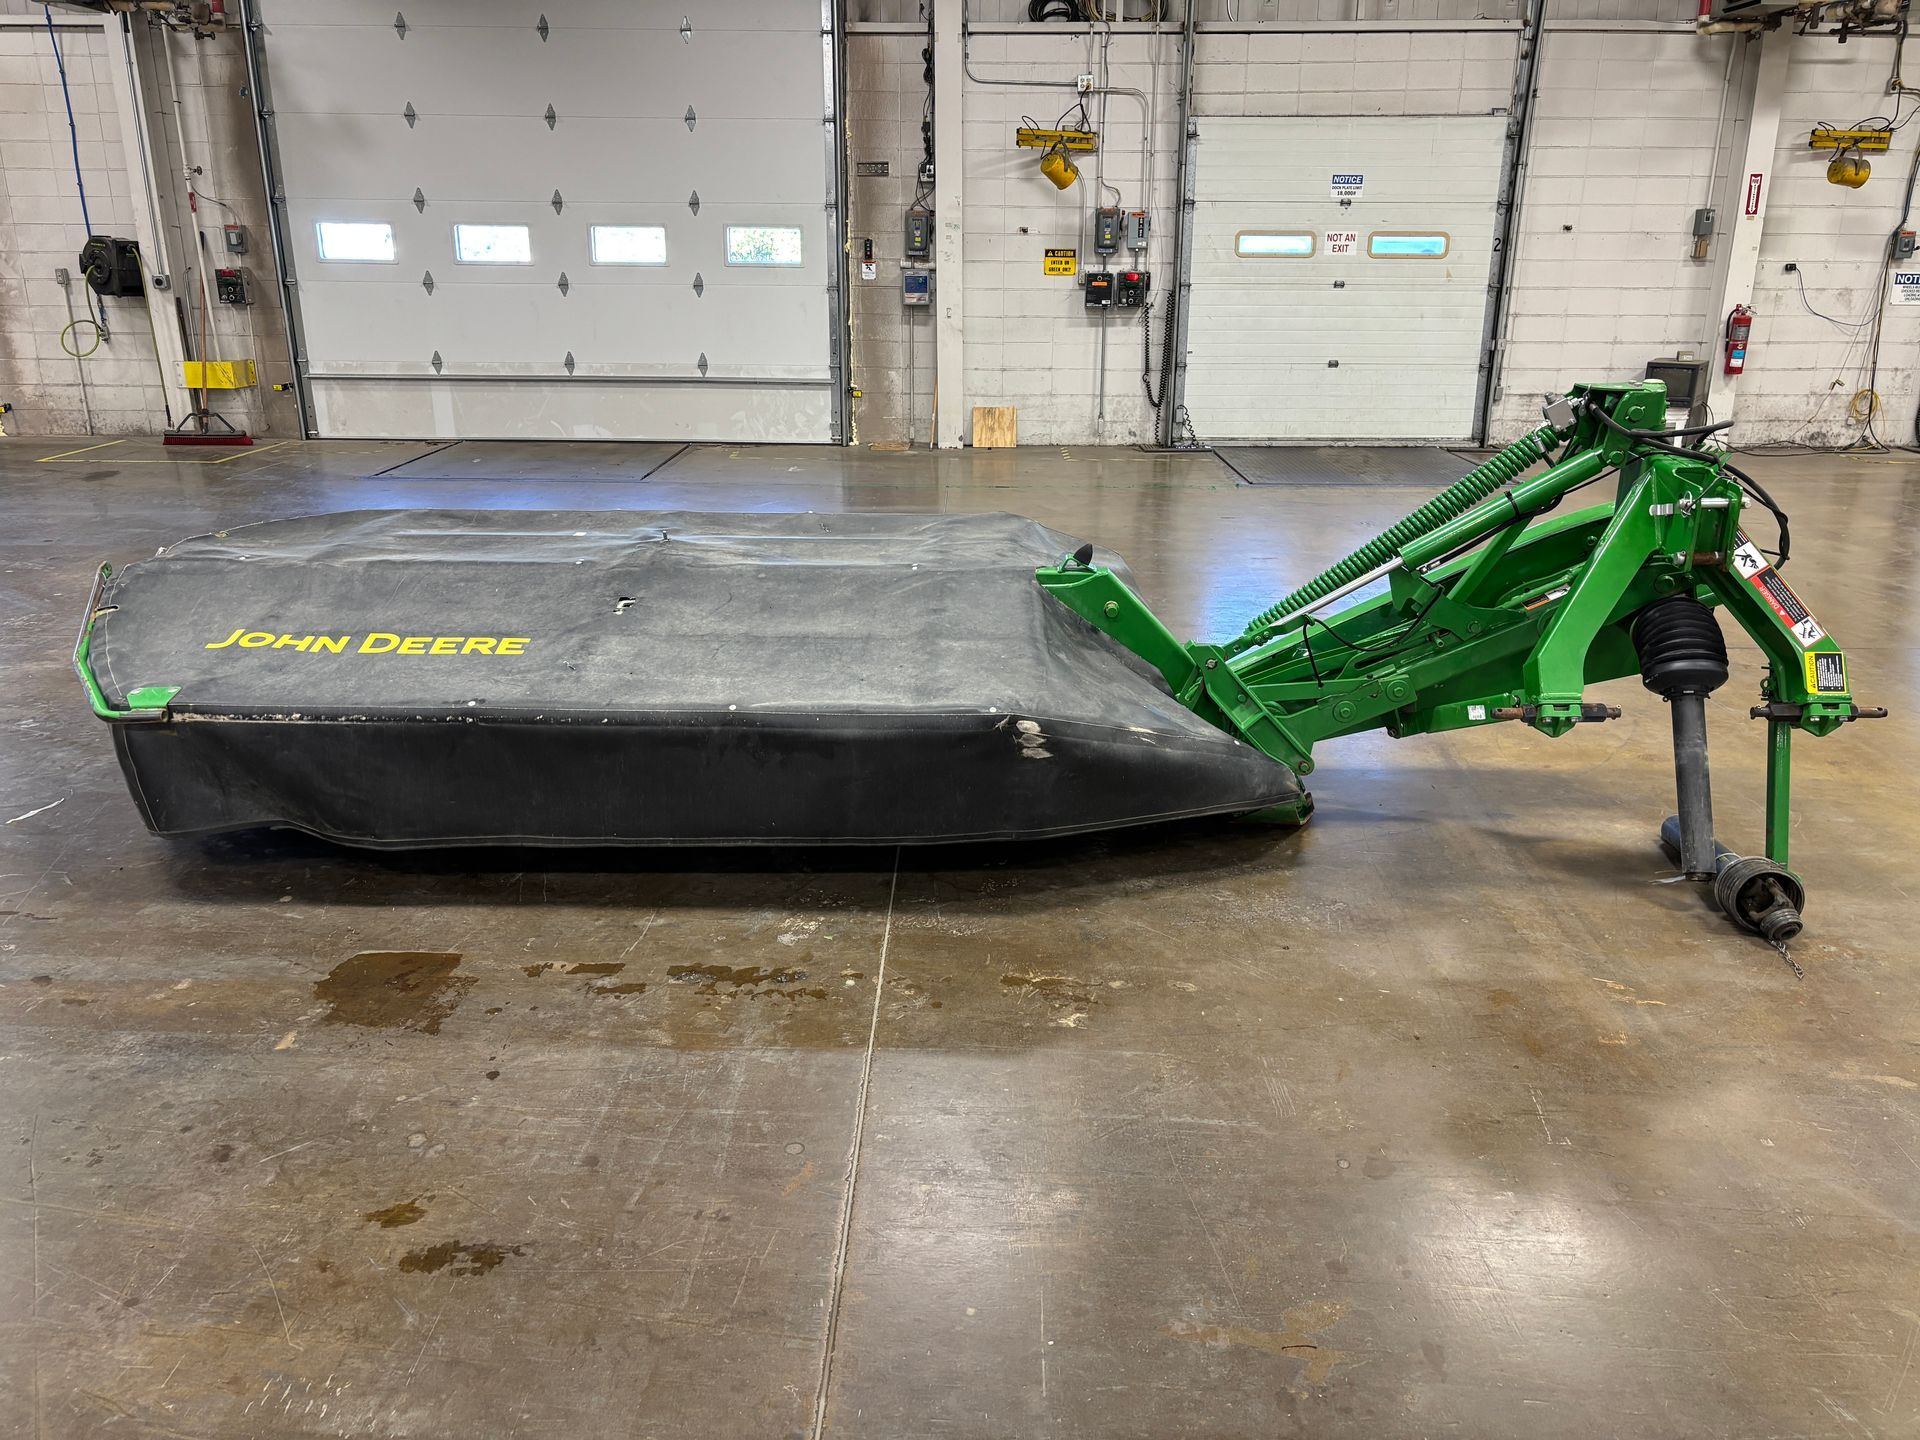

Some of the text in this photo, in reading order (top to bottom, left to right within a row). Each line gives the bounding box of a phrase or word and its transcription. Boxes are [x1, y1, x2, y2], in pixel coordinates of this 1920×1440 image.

[1333, 175, 1362, 184] NOTICE
[1327, 233, 1356, 242] NOT AN
[1332, 244, 1349, 253] EXIT
[1493, 237, 1502, 252] 2
[1758, 585, 1780, 611] DANGER
[205, 628, 531, 655] JOHN DEERE
